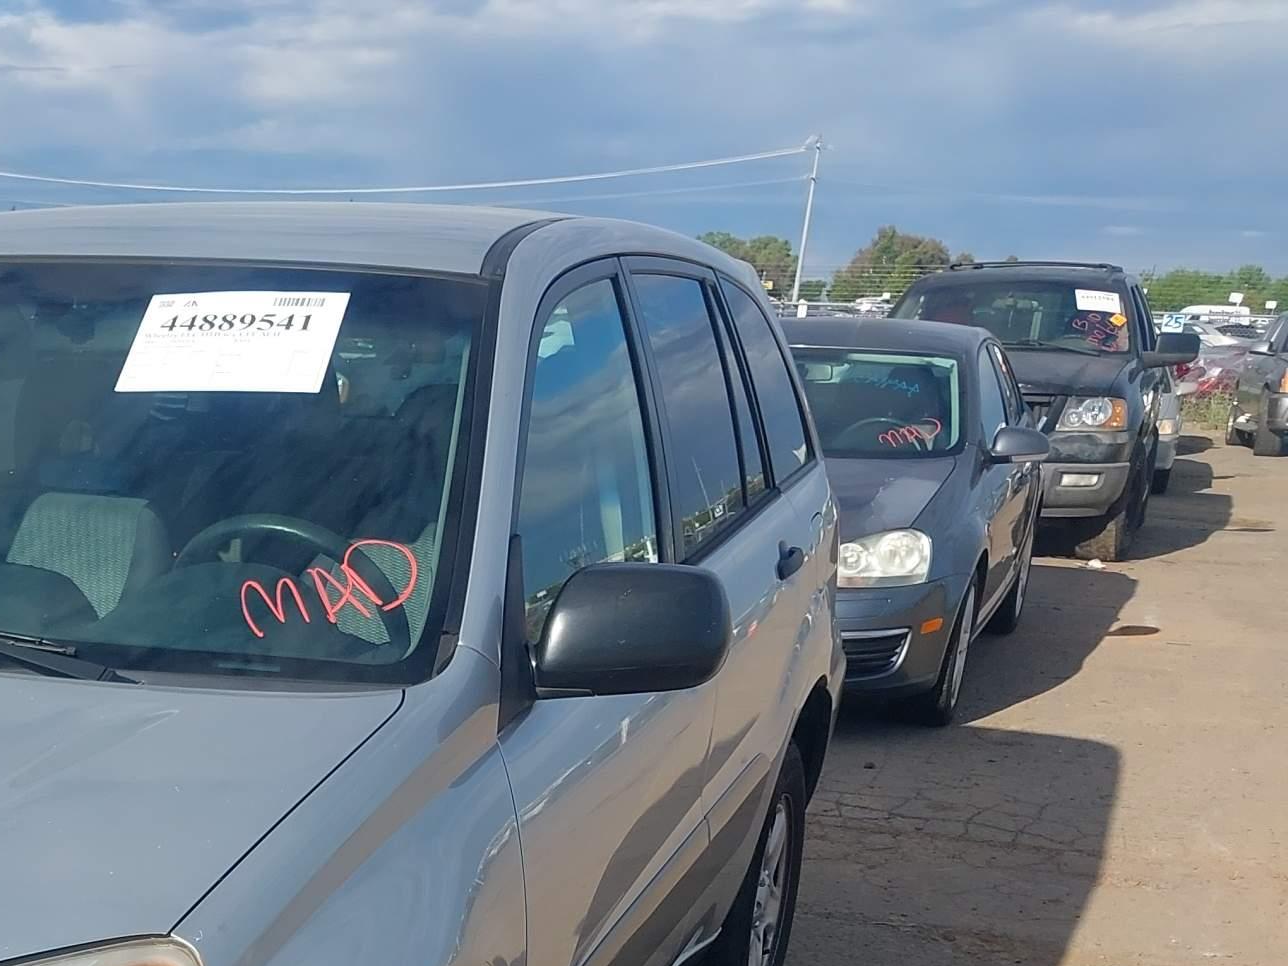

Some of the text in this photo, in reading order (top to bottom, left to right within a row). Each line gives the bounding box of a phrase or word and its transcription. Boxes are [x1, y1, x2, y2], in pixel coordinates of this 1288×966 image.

[161, 313, 312, 332] 44889541
[1164, 315, 1184, 329] 25
[240, 538, 418, 639] MAD
